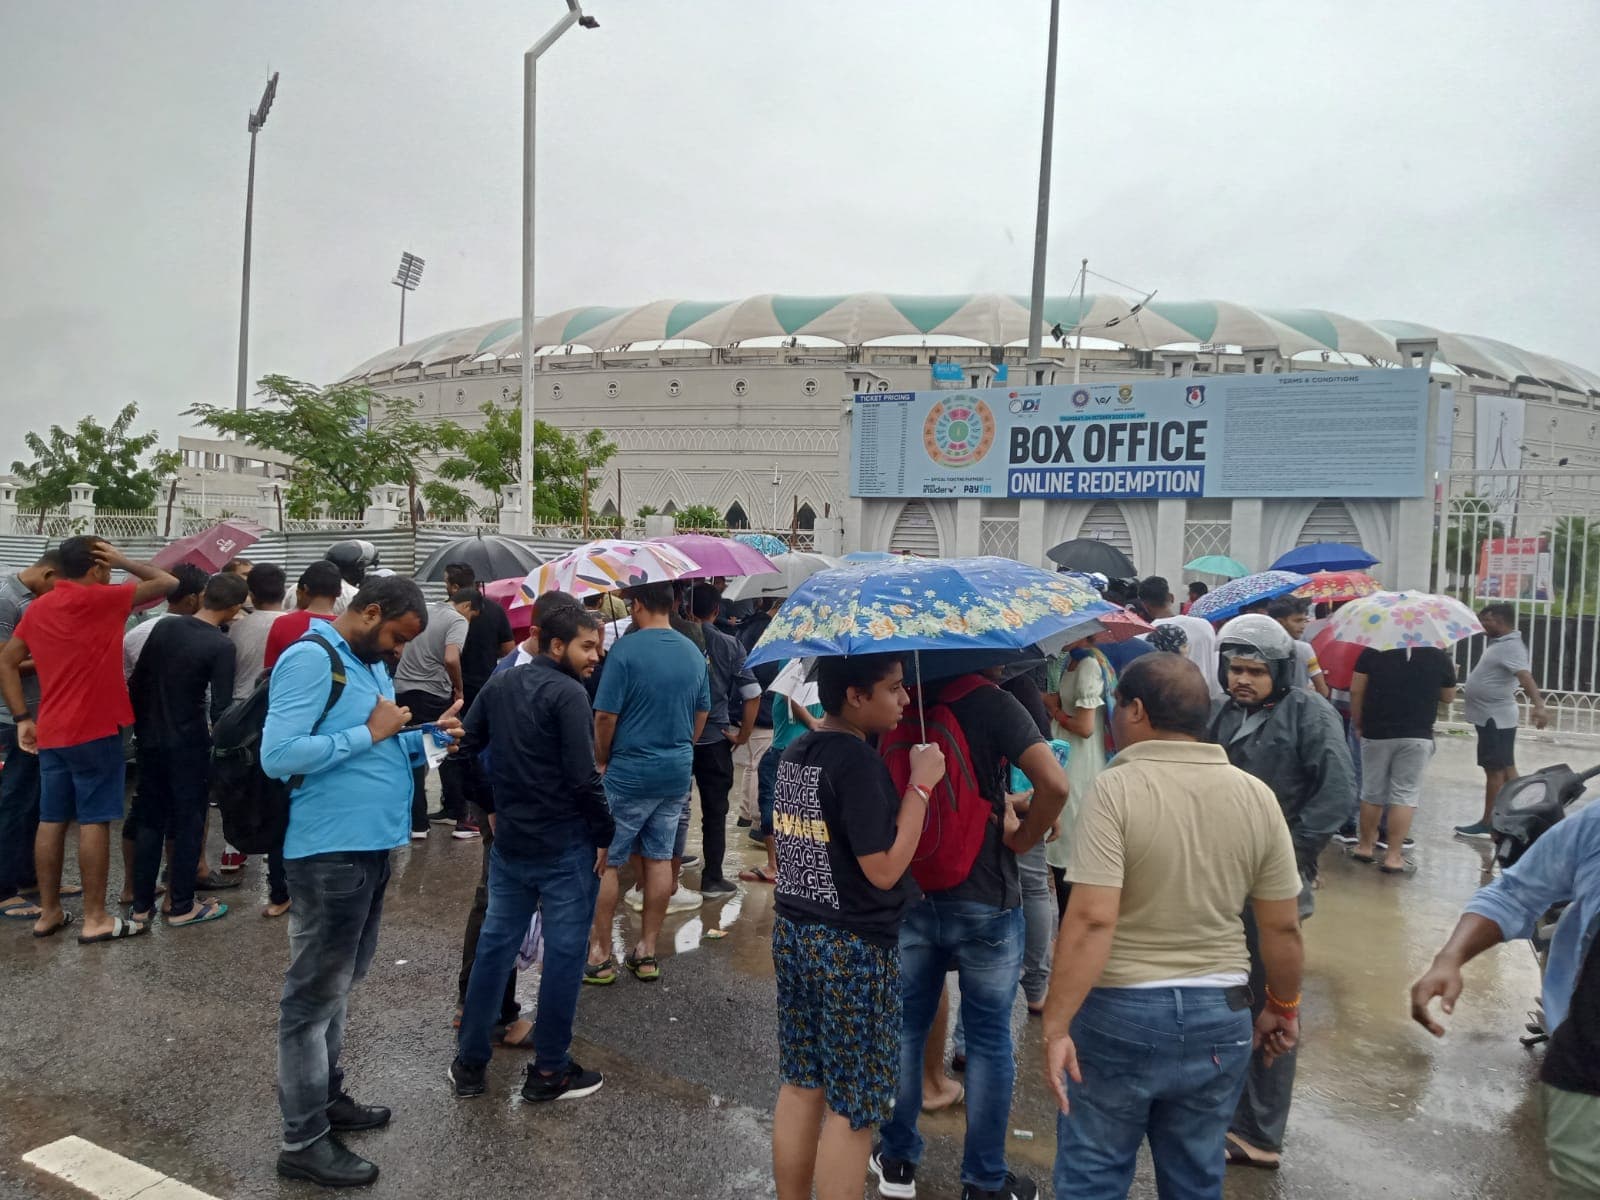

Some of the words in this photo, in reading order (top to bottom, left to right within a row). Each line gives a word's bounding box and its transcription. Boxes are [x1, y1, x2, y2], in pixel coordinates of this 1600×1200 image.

[1009, 424, 1076, 464] BOX
[1083, 420, 1208, 463] OFFICE
[1011, 472, 1074, 494] ONLINE
[1078, 470, 1200, 493] REDEMPTION
[775, 840, 832, 871] AVAGE!
